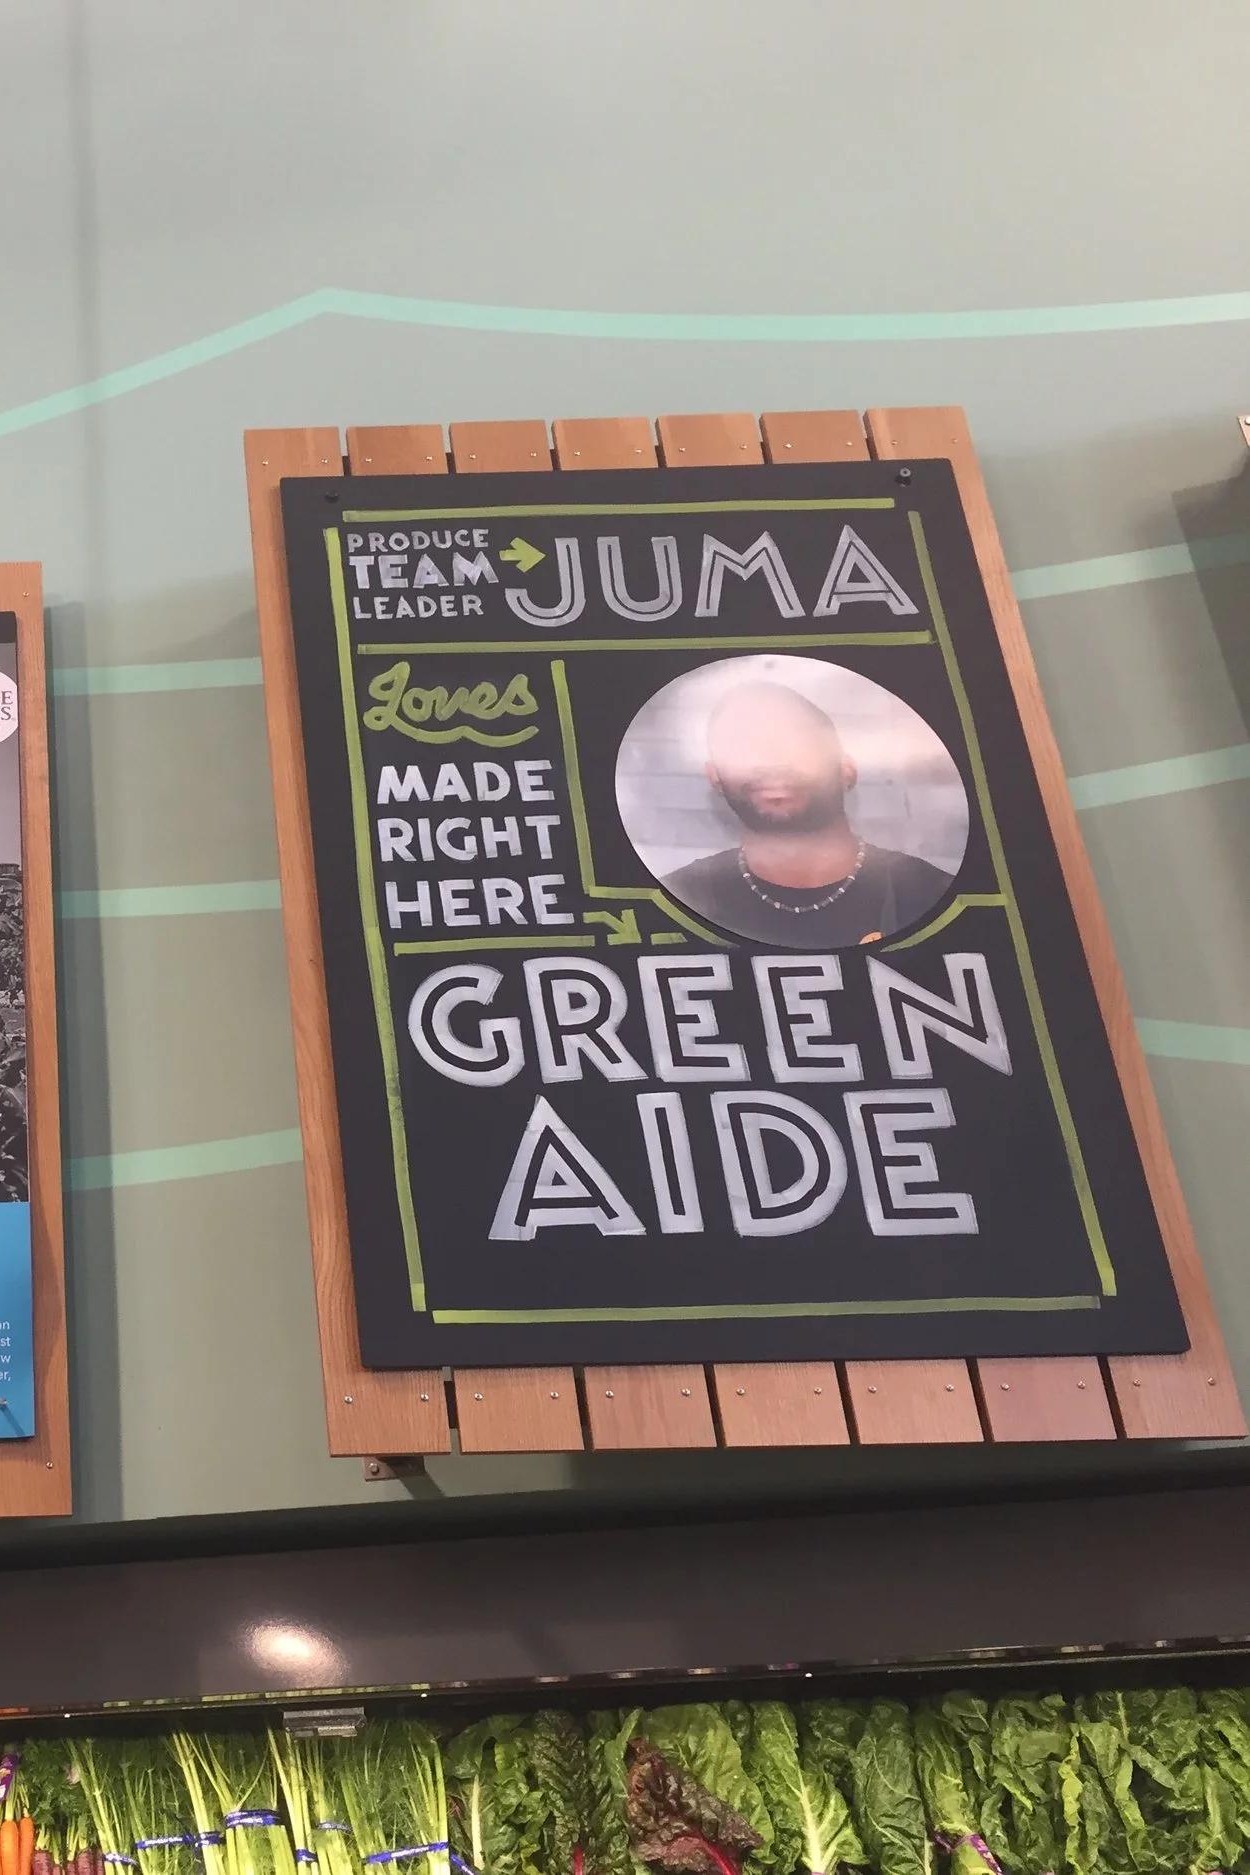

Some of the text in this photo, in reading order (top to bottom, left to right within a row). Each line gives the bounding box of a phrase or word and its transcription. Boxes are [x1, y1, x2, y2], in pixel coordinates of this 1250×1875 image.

[346, 529, 489, 552] PRODUCE
[349, 551, 499, 589] TEAM
[505, 524, 919, 628] JUMA
[353, 594, 484, 619] LEADER
[363, 661, 539, 748] Loves
[377, 760, 555, 804] MADE
[377, 814, 560, 862] RIGHT
[385, 873, 575, 929] HERE
[408, 953, 1013, 1087] GREEN
[488, 1088, 978, 1241] AIDE
